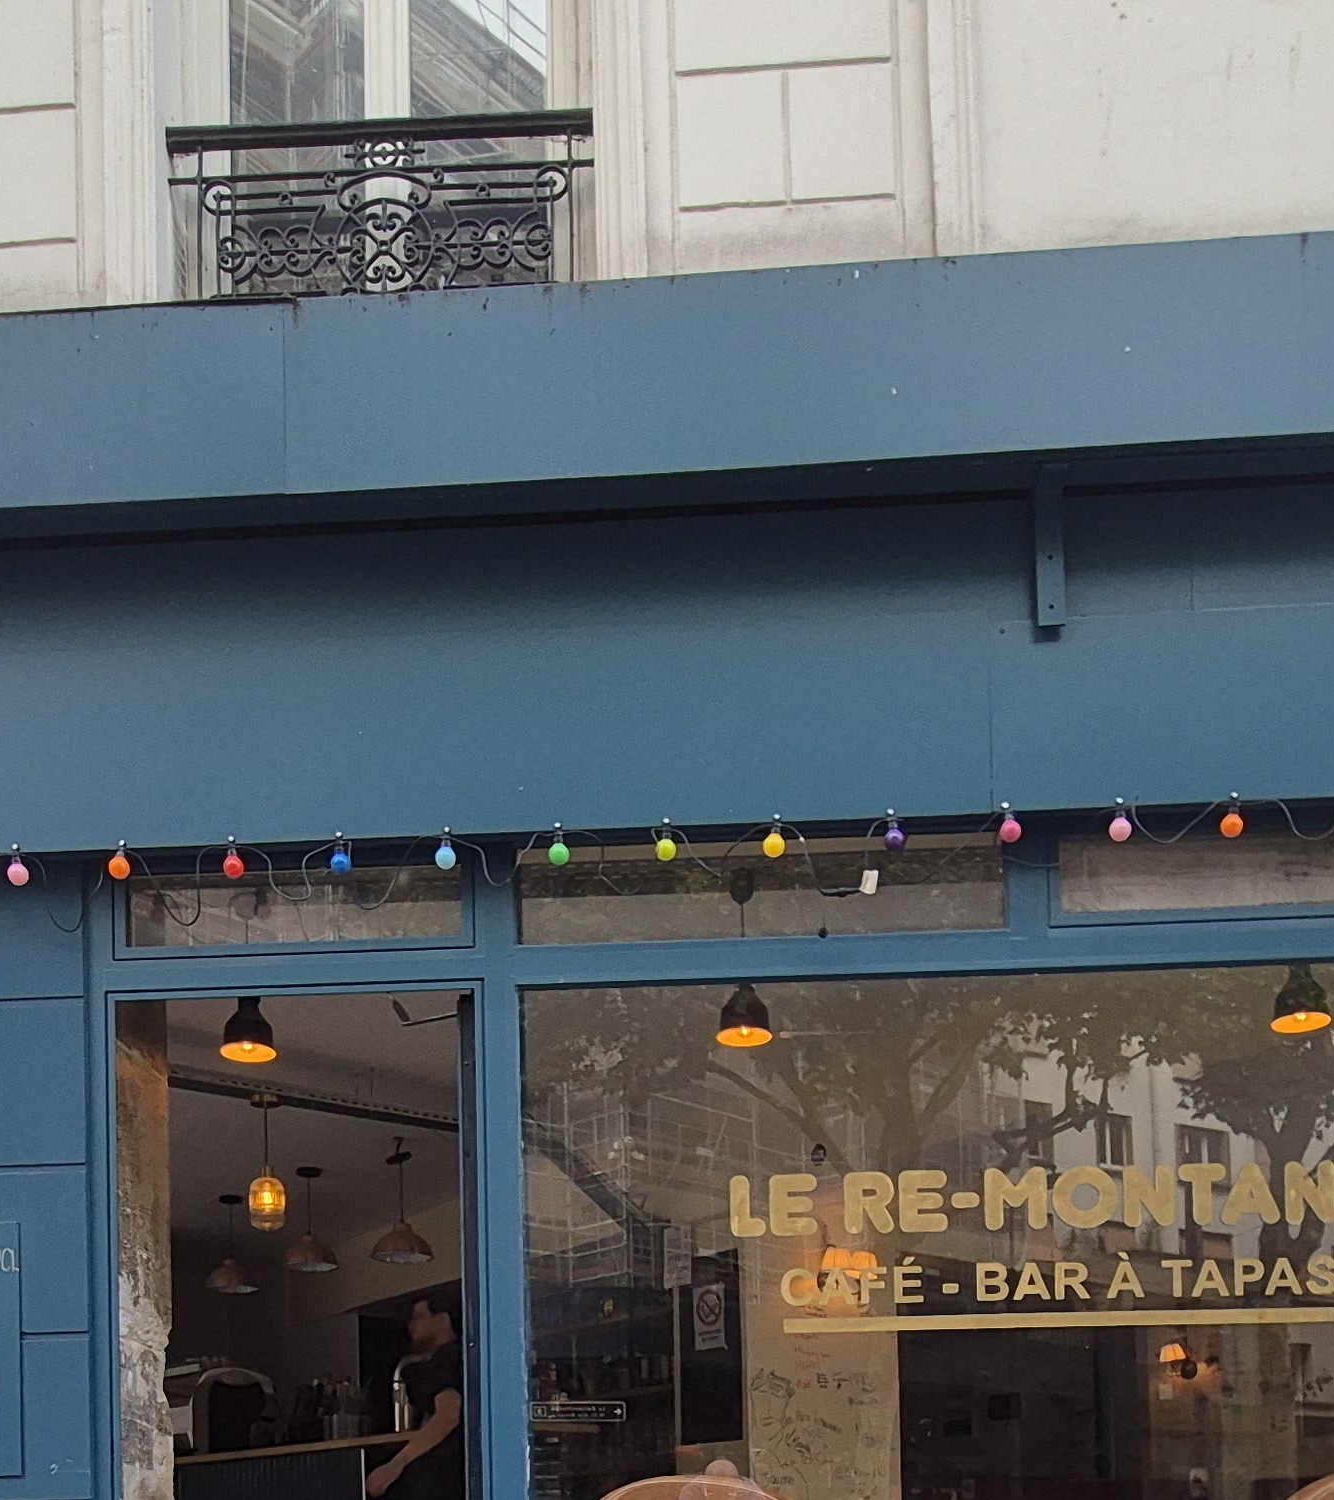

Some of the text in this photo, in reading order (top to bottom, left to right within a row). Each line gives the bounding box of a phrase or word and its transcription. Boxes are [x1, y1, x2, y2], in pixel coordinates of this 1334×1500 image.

[728, 1172, 820, 1240] LE
[778, 1255, 926, 1308] CAFÉ
[975, 1259, 1091, 1302] BAR
[1107, 1250, 1145, 1300] À
